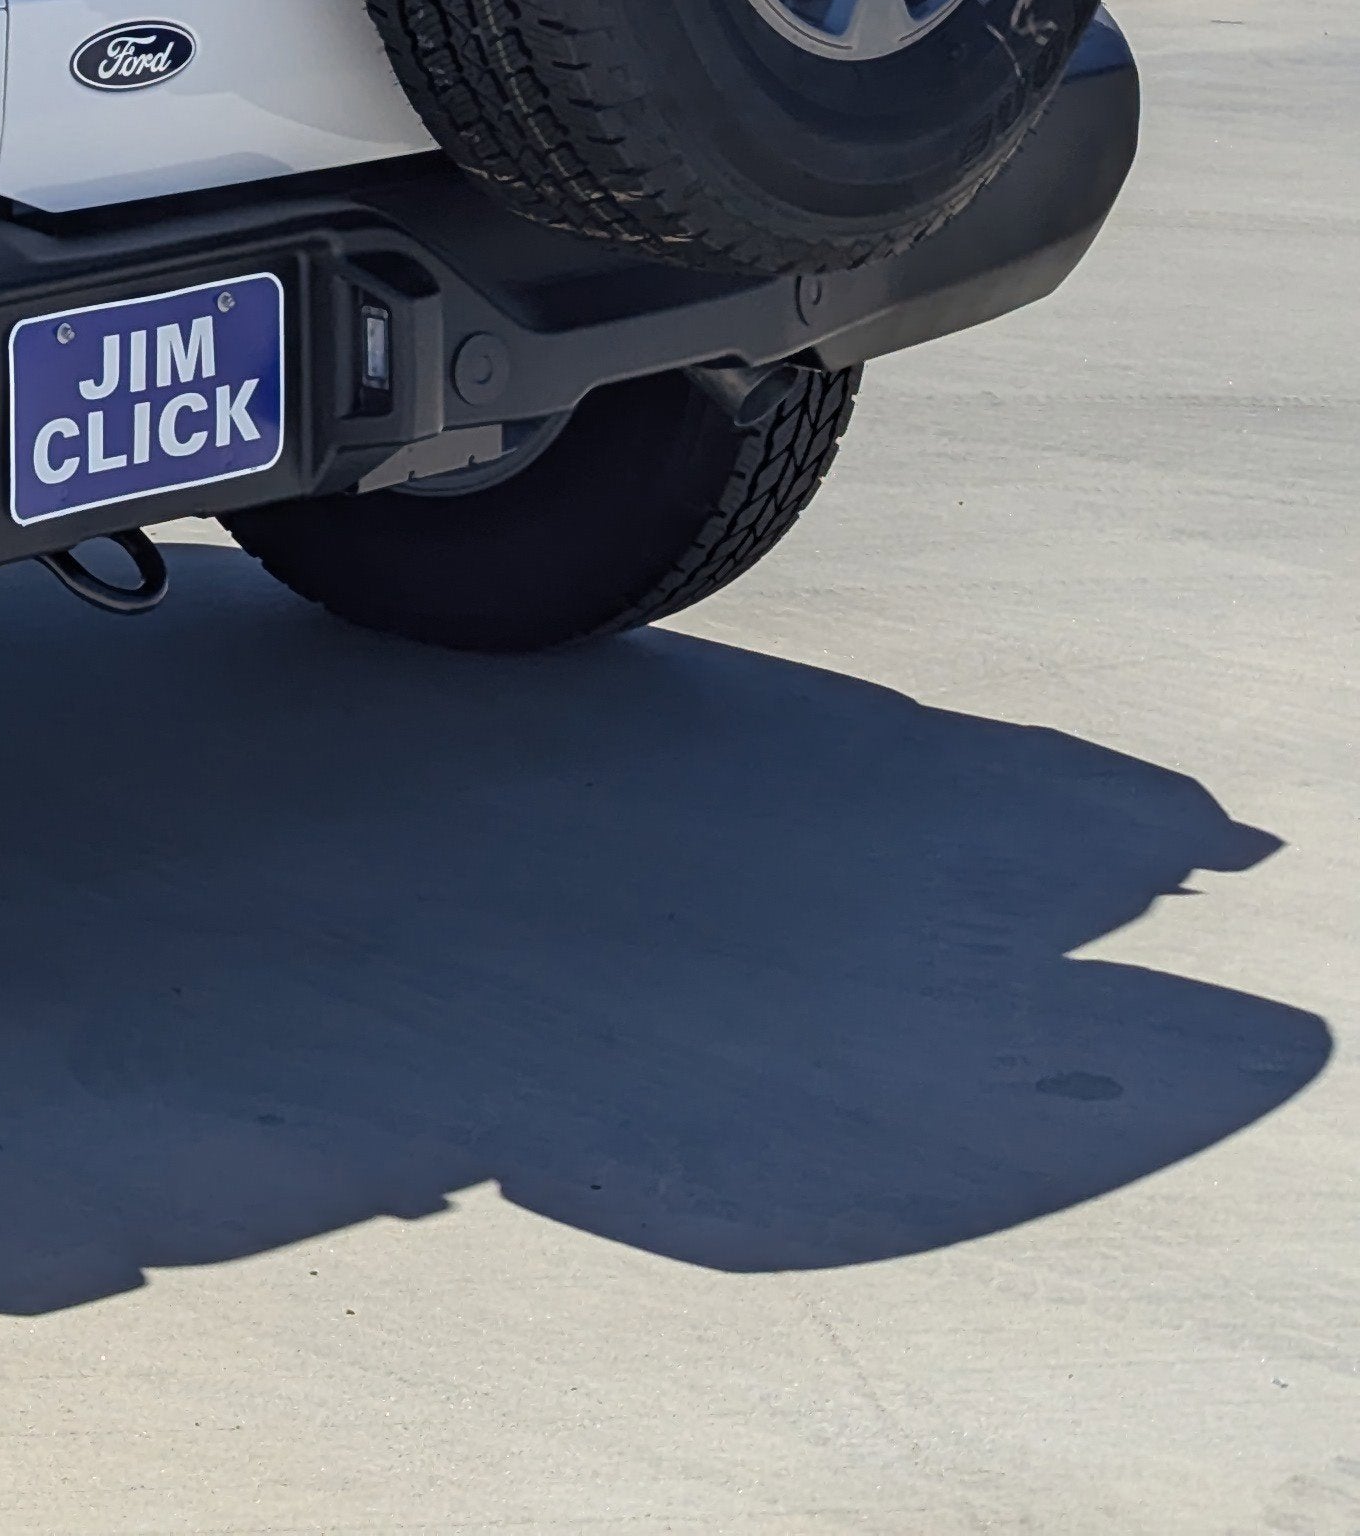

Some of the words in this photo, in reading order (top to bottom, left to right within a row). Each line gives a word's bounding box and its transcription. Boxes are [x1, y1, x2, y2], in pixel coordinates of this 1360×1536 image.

[99, 35, 175, 81] Ford
[78, 314, 217, 401] JIM
[32, 378, 261, 486] CLICK
